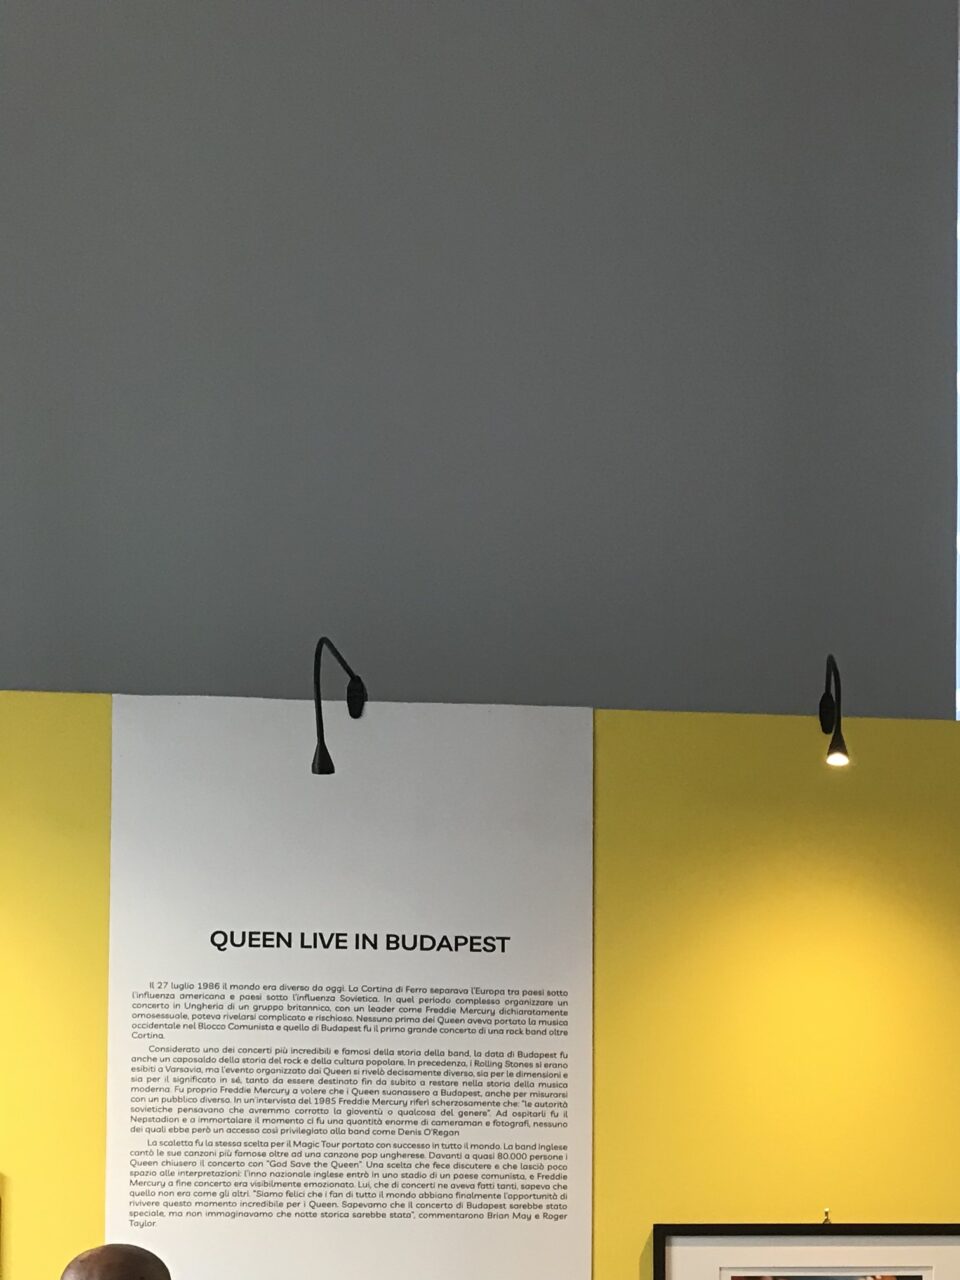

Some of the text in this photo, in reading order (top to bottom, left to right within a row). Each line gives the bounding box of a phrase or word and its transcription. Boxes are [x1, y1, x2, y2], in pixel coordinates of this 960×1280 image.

[211, 931, 511, 952] QUEEN LIVE IN BUDAPEST
[360, 984, 392, 993] Cortina
[429, 987, 468, 996] separava
[179, 991, 225, 1000] americana
[455, 996, 500, 1006] complesso
[504, 997, 553, 1007] organizzare
[131, 1001, 169, 1009] concerto
[184, 1001, 223, 1012] Ungheria
[498, 1007, 568, 1015] dichiaratamente
[222, 1012, 256, 1020] rivelarsi
[258, 1013, 306, 1023] complicato
[131, 1021, 476, 1034] occidentale Comunista Budapest concerto
[148, 1044, 556, 1060] Considerato concerti incredibili Budapest
[172, 1055, 216, 1065] caposaldo
[474, 1059, 502, 1069] Rolling
[255, 1066, 306, 1076] organizzato
[386, 1068, 441, 1076] decisamente
[515, 1069, 561, 1078] dimensioni
[172, 1075, 458, 1086] significato destinato restare
[529, 1089, 567, 1098] misurarsi
[161, 1095, 197, 1105] pubblico
[431, 1098, 500, 1107] scherzosamente
[130, 1105, 546, 1119] sovietiche pensavano qualcosa ospitarli
[130, 1115, 179, 1125] Nepstadion
[197, 1115, 252, 1124] immortalare
[280, 1126, 328, 1137] privilegiato
[159, 1138, 193, 1147] scaletta
[538, 1142, 567, 1152] inglese
[183, 1149, 216, 1157] canzoni
[428, 1151, 462, 1159] Davanti
[529, 1154, 563, 1162] persone
[161, 1158, 491, 1169] chiusero concerto discutere
[269, 1170, 311, 1178] nazionale
[313, 1170, 343, 1180] inglese
[537, 1172, 567, 1180] Freddie
[129, 1179, 435, 1189] Mercury concerto visibilmente concerti
[418, 1191, 453, 1199] abbiano
[455, 1191, 501, 1199] finalmente
[239, 1200, 506, 1211] incredibile Sapevamo concerto Budapest
[205, 1209, 273, 1219] immaginavamo
[352, 1210, 386, 1218] sarebbe
[418, 1211, 484, 1219] commentarono
